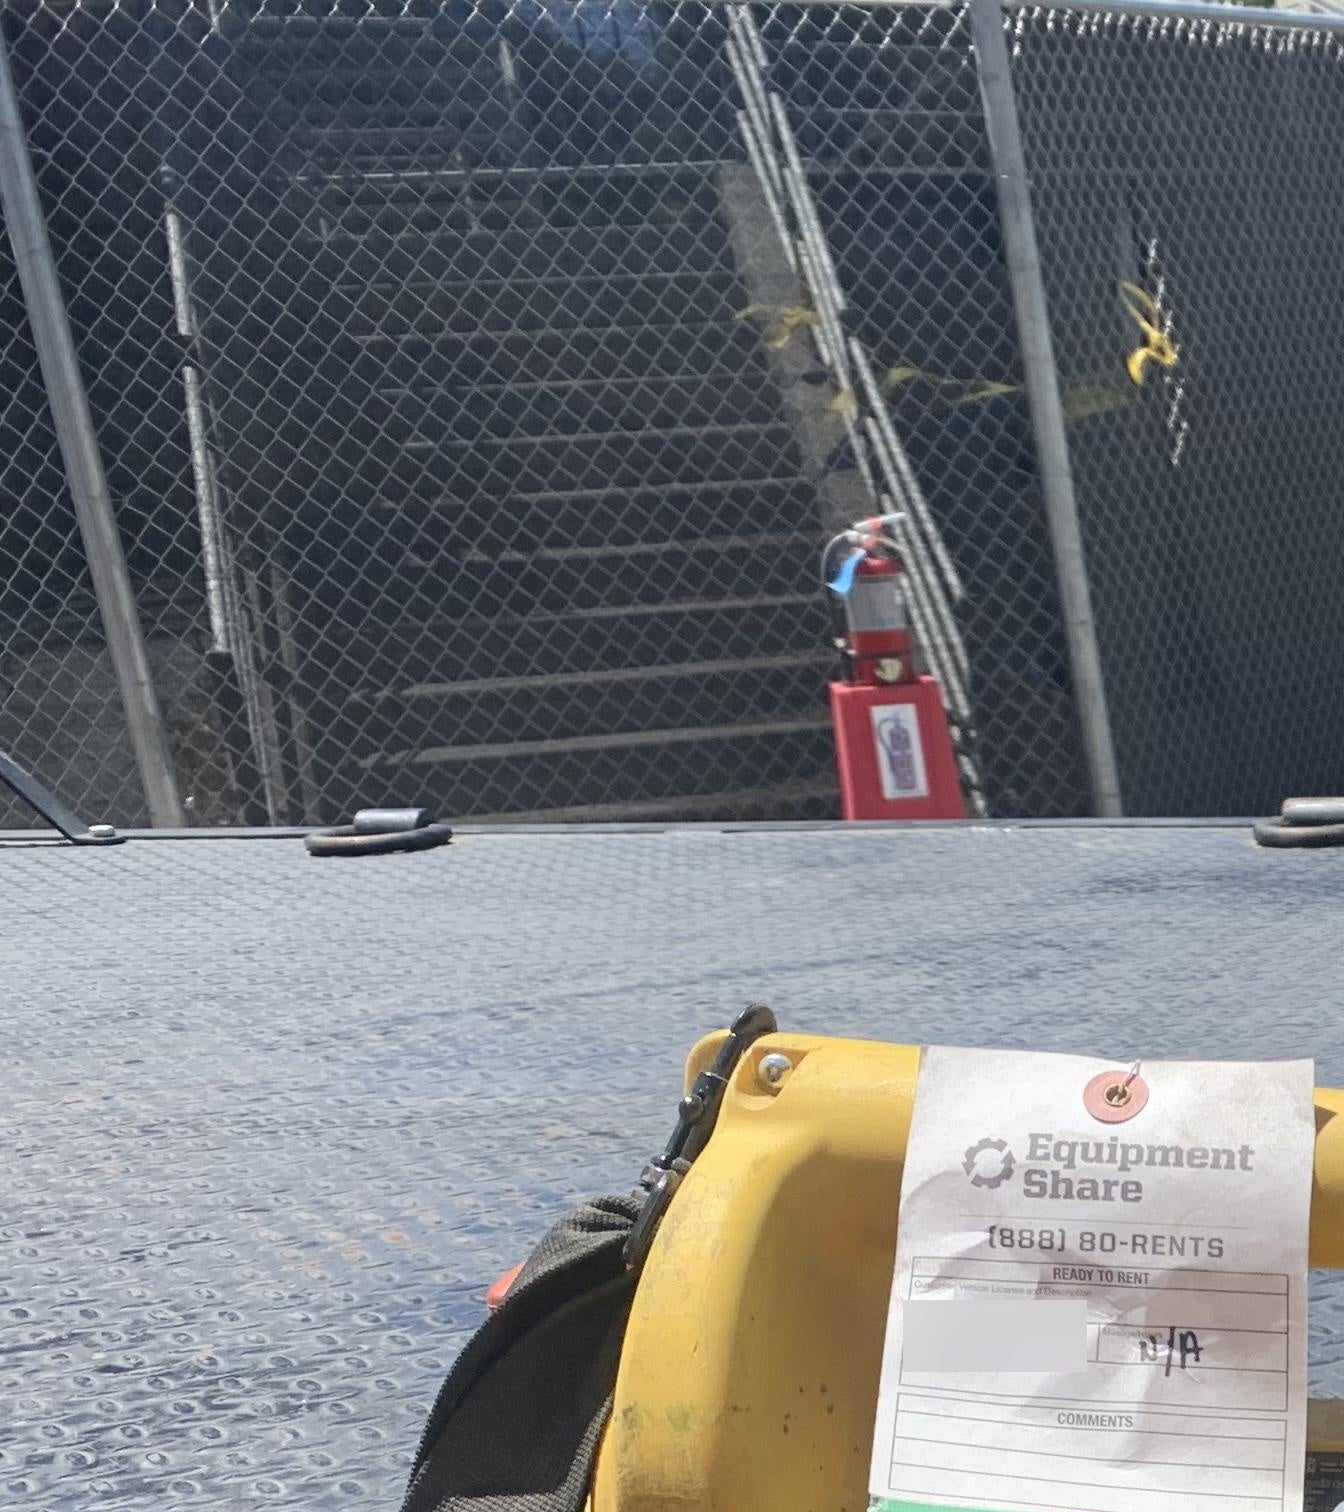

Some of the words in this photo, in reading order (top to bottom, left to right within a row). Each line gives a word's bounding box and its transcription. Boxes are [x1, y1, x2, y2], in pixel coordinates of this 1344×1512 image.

[1026, 1133, 1255, 1172] Equipment
[1023, 1168, 1143, 1203] Share
[1079, 1231, 1224, 1258] 80-RENTS
[1053, 1267, 1093, 1281] READY
[1097, 1270, 1114, 1283] TO
[1118, 1271, 1150, 1284] RENT
[1139, 1326, 1203, 1376] N/A
[1057, 1412, 1134, 1428] COMMENTS
